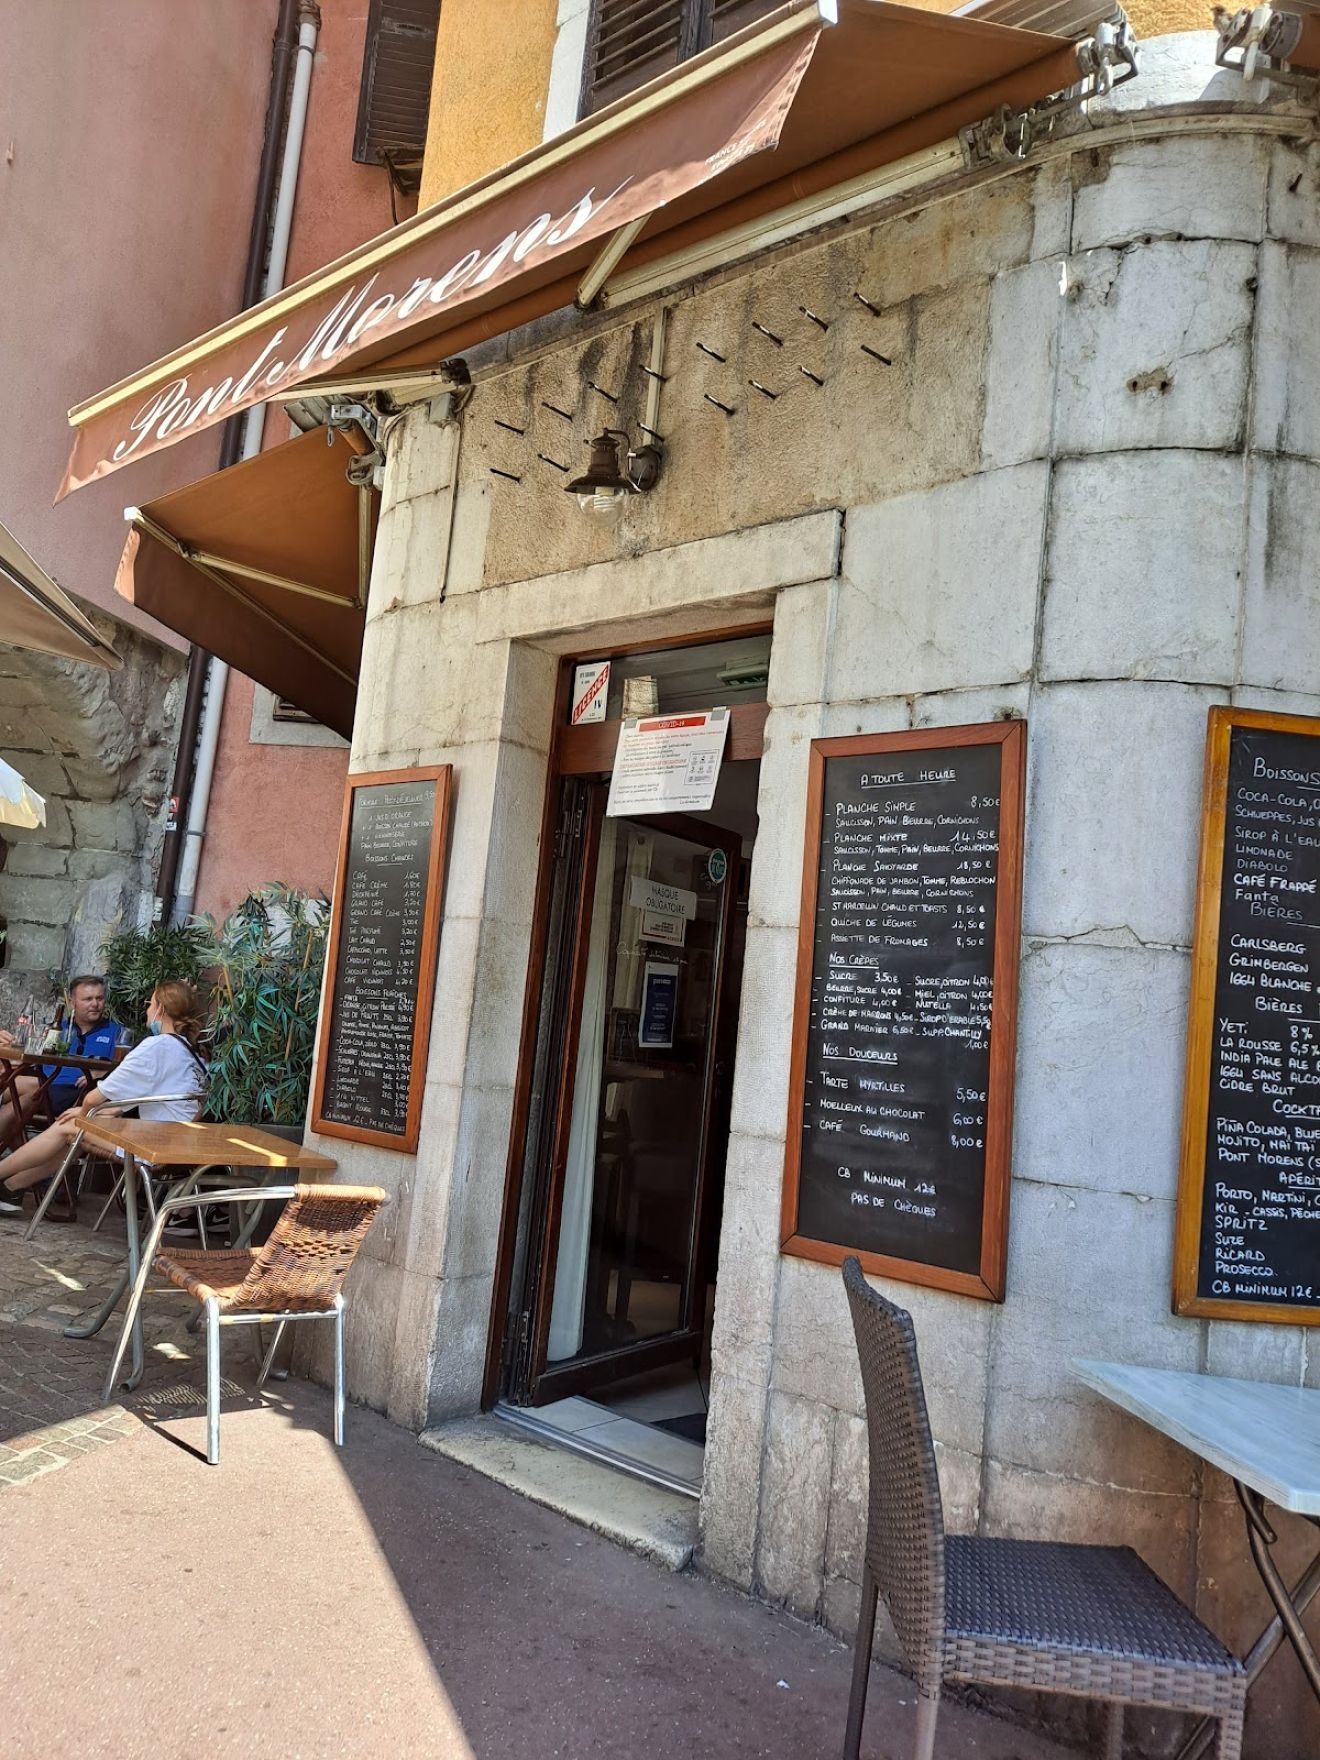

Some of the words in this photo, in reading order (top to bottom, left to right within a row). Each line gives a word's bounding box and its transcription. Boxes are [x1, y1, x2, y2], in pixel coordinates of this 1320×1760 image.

[113, 326, 289, 461] Pont
[267, 175, 634, 386] Morens
[861, 774, 868, 786] A
[871, 772, 905, 784] TOUTE
[920, 770, 956, 781] HEURE
[1253, 757, 1320, 786] BOISSONS
[836, 802, 879, 816] PLANCHE
[884, 800, 917, 813] SIMPLE
[878, 816, 898, 826] PAIN
[1297, 815, 1316, 828] JUS
[834, 832, 873, 844] PLANCHE
[880, 833, 908, 842] MIXTE
[1235, 826, 1267, 842] SIROP
[1272, 829, 1280, 842] À
[954, 842, 1000, 855] CORNICHONS
[1236, 842, 1297, 861] LIMONADE
[833, 859, 867, 872] PLANCHE
[873, 860, 919, 872] SAVOYARDE
[1237, 858, 1288, 873] DIABOLO
[876, 877, 887, 886] DE
[950, 876, 996, 885] REBLOCHON
[1234, 872, 1266, 888] CAFÉ
[1270, 876, 1317, 894] FRAPPÉ
[1235, 889, 1280, 903] Fanta
[832, 902, 841, 911] ST
[910, 904, 920, 912] ET
[920, 904, 948, 914] TOASTS
[1250, 901, 1303, 921] BIÈRES
[830, 917, 862, 927] QUICHE
[866, 918, 877, 927] DE
[830, 933, 865, 944] ASSIETTE
[868, 934, 881, 945] DE
[884, 934, 929, 947] FROMAGES
[1231, 934, 1307, 955] CARLSBERG
[829, 952, 845, 965] NOS
[1229, 952, 1309, 974] GRIMBERGEN
[829, 971, 858, 982] SUCRE
[1230, 971, 1256, 987] 1664
[1260, 972, 1313, 993] BLANCHE
[824, 994, 867, 1005] CONFITURE
[916, 1000, 952, 1011] NUTELLA
[1255, 996, 1303, 1014] BIÈRES
[848, 1009, 858, 1018] DE
[920, 1012, 942, 1024] SIROP
[820, 1018, 849, 1032] GRAND
[854, 1022, 889, 1035] MARNIER
[944, 1026, 982, 1041] CHANTILLY
[822, 1042, 840, 1056] NOS
[848, 1046, 898, 1061] DOUCEURS
[1220, 1036, 1234, 1048] LA
[1238, 1038, 1283, 1052] ROUSSE
[1220, 1050, 1251, 1064] INDIA
[1255, 1052, 1283, 1067] PALE
[1288, 1057, 1310, 1071] ALE
[820, 1070, 849, 1090] TARTE
[859, 1076, 906, 1093] MYRTILLES
[1252, 1068, 1282, 1082] SANS
[1219, 1078, 1254, 1093] CIDRE
[1262, 1082, 1297, 1096] BRUT
[820, 1098, 864, 1114] MOELLEUX
[866, 1106, 878, 1116] AU
[879, 1106, 926, 1120] CHOCOLAT
[819, 1119, 844, 1133] CAFÉ
[859, 1124, 911, 1143] GOURMAND
[1218, 1147, 1251, 1163] PONT
[1258, 1152, 1304, 1167] MORENS
[837, 1166, 851, 1179] CB
[864, 1170, 907, 1190] MINIMUM
[850, 1192, 870, 1207] PAS
[872, 1196, 885, 1208] DE
[1215, 1202, 1239, 1215] KIR
[1215, 1214, 1269, 1232] SPRITZ
[1215, 1232, 1245, 1246] SUZE
[1215, 1246, 1266, 1262] RICARD
[1212, 1279, 1232, 1295] CB
[1236, 1282, 1288, 1299] MINIMUM
[1292, 1285, 1313, 1300] 12€
